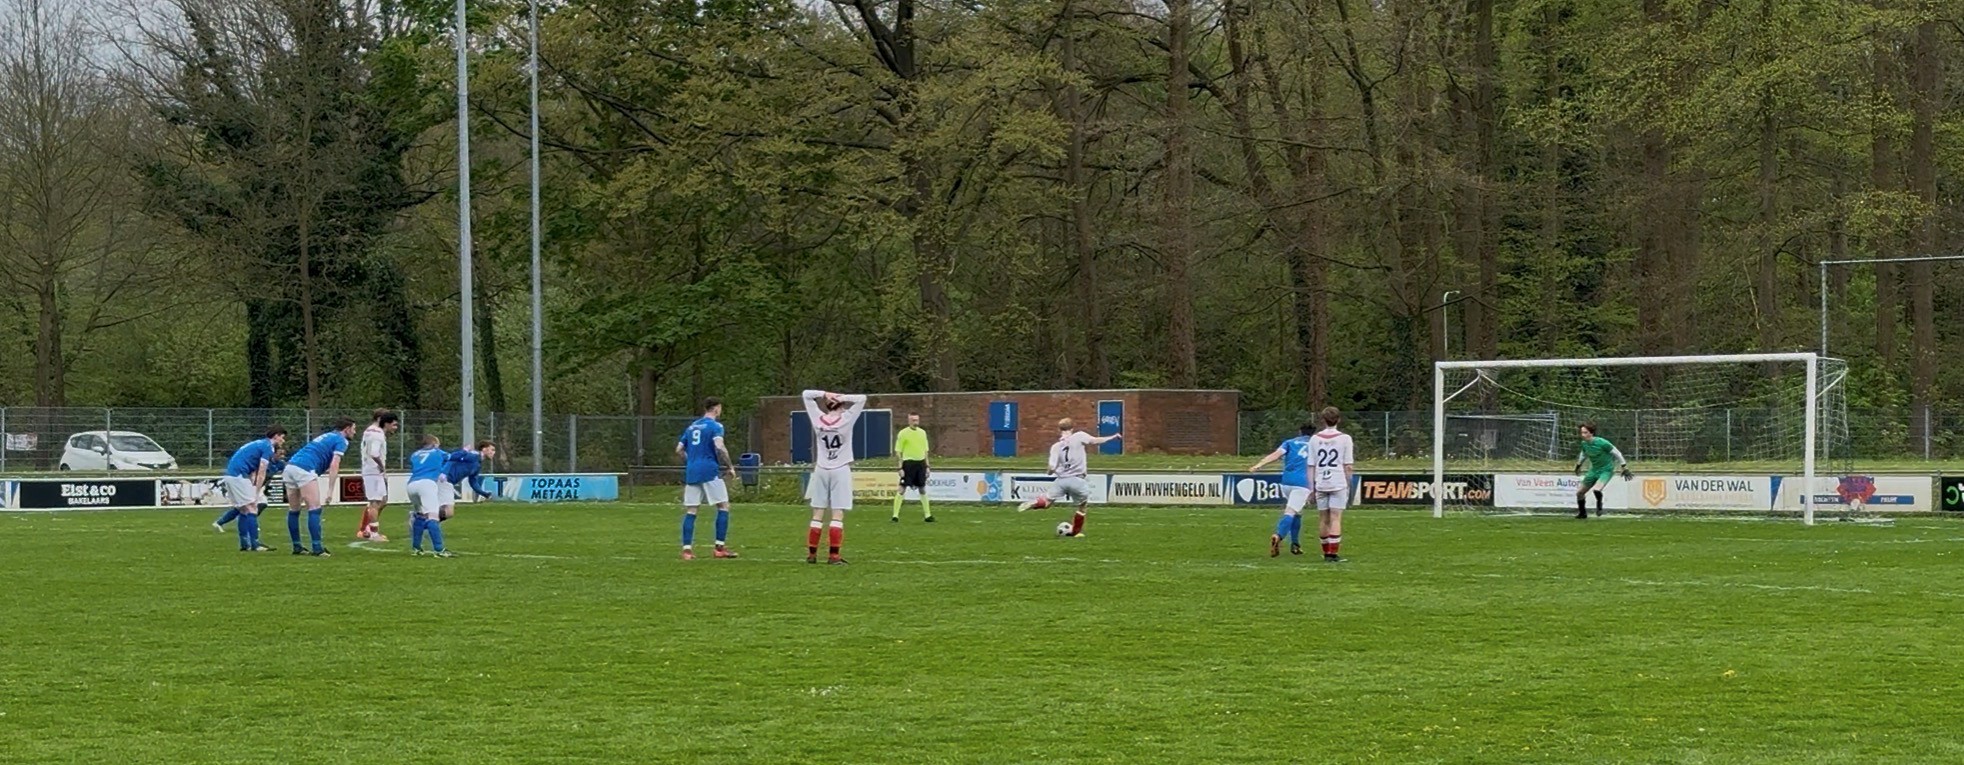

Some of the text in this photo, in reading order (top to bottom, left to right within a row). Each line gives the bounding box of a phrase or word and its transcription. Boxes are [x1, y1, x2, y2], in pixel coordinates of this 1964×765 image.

[692, 429, 701, 445] 9
[822, 434, 843, 450] 14
[419, 452, 430, 464] 7
[1318, 448, 1339, 468] 22
[347, 481, 366, 493] GE
[531, 478, 580, 489] TOPAAS
[1516, 478, 1531, 486] Van
[1533, 478, 1554, 486] Veen
[1675, 480, 1754, 492] VAN DER WAL
[531, 489, 580, 500] METAAL
[1115, 482, 1221, 498] WWW.HVVHENGELO.NL
